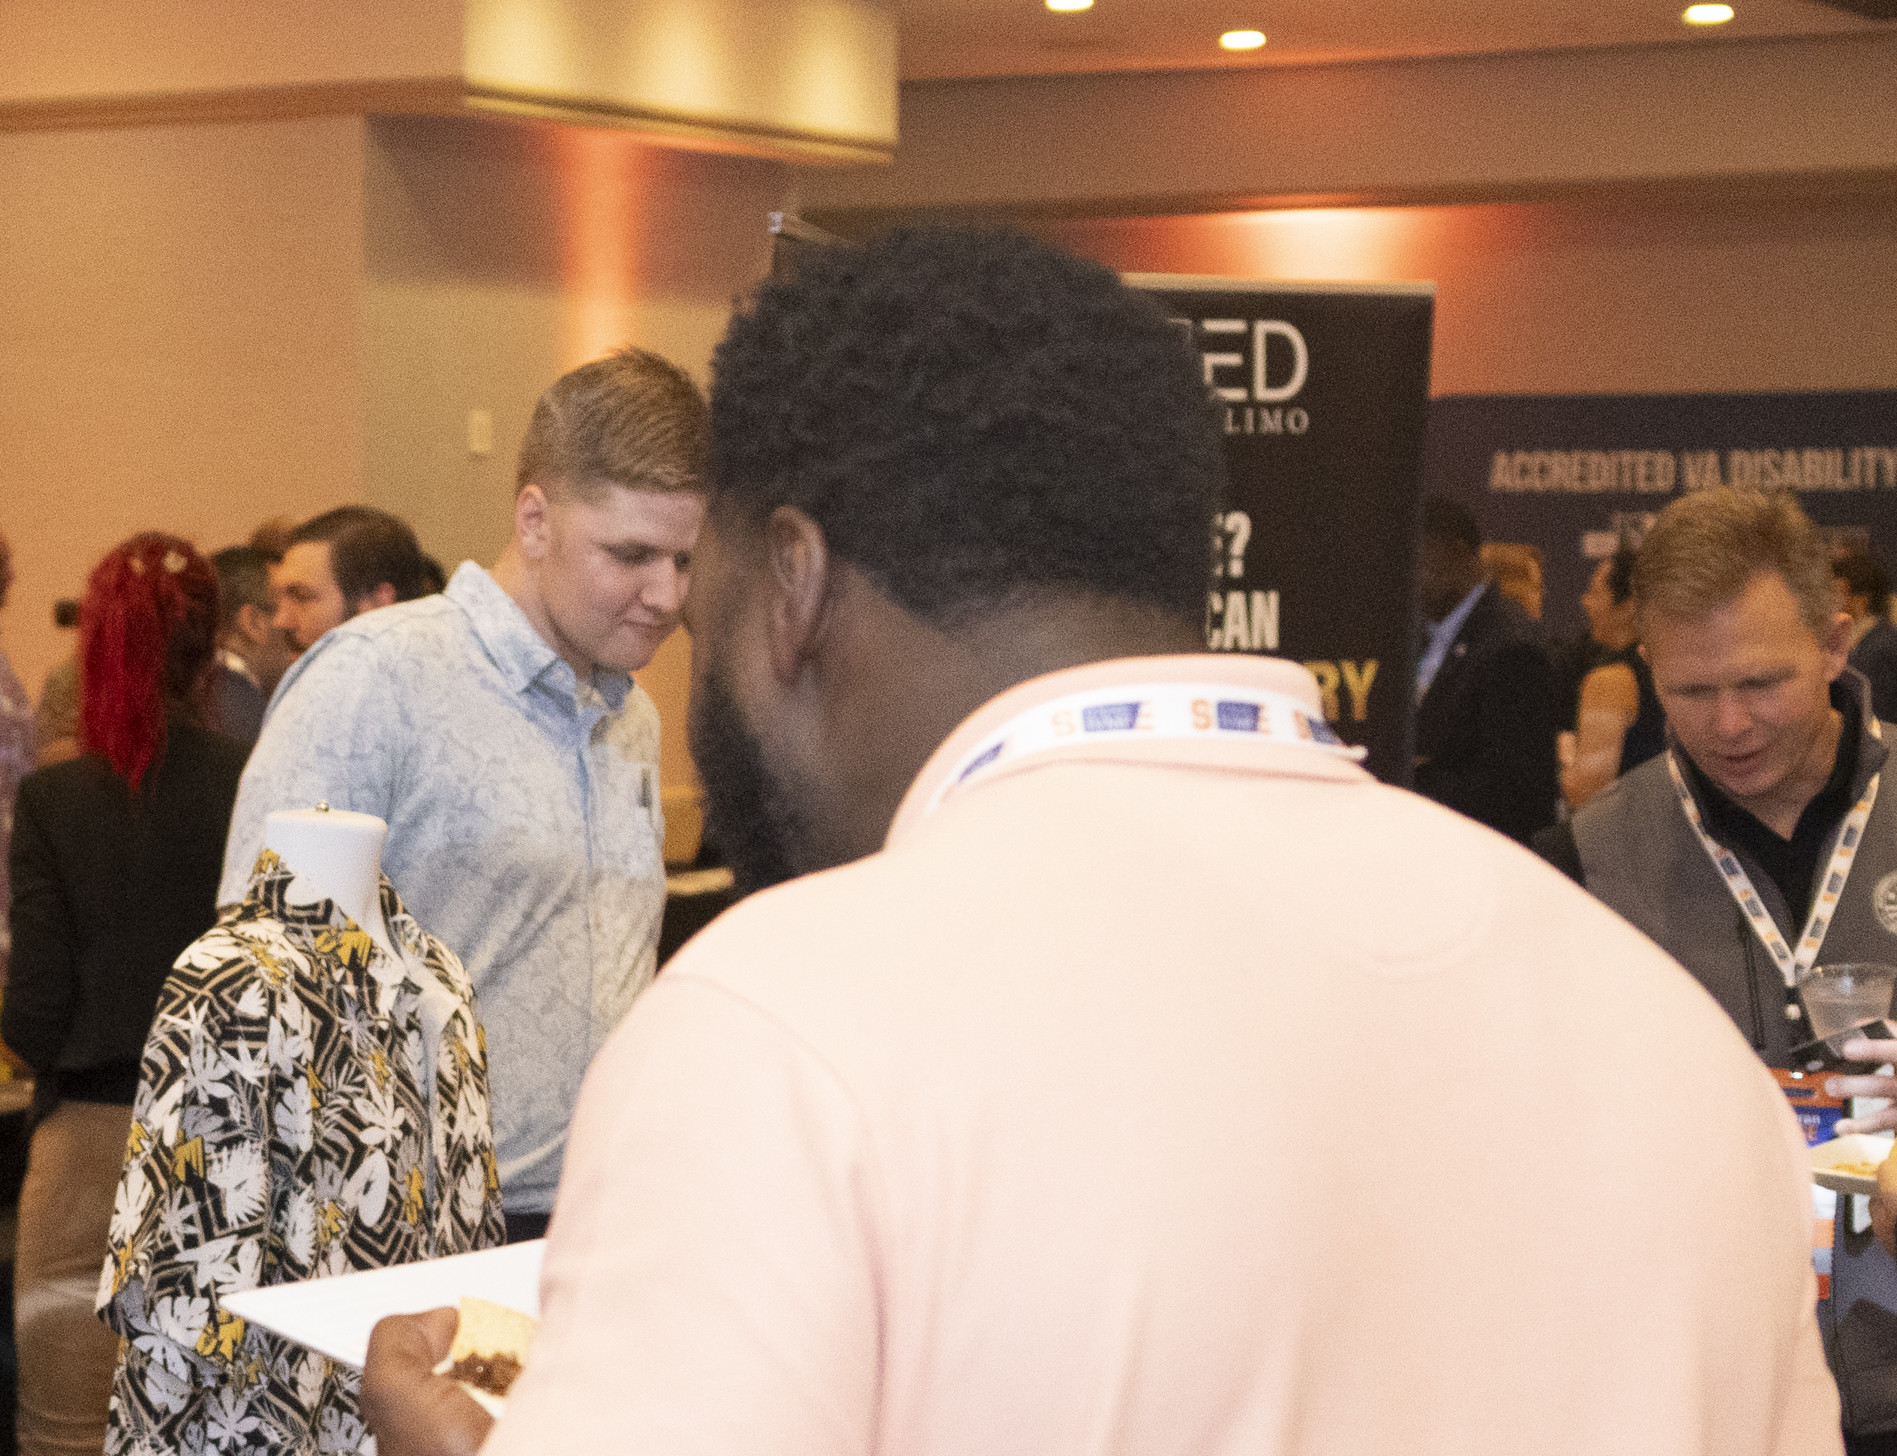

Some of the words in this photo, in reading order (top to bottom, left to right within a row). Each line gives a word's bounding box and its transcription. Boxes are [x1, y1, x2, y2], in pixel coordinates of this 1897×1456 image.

[1186, 317, 1309, 402] ED
[1223, 406, 1309, 435] LIMO
[1489, 449, 1676, 492] ACCREDITED
[1684, 449, 1721, 491] VA
